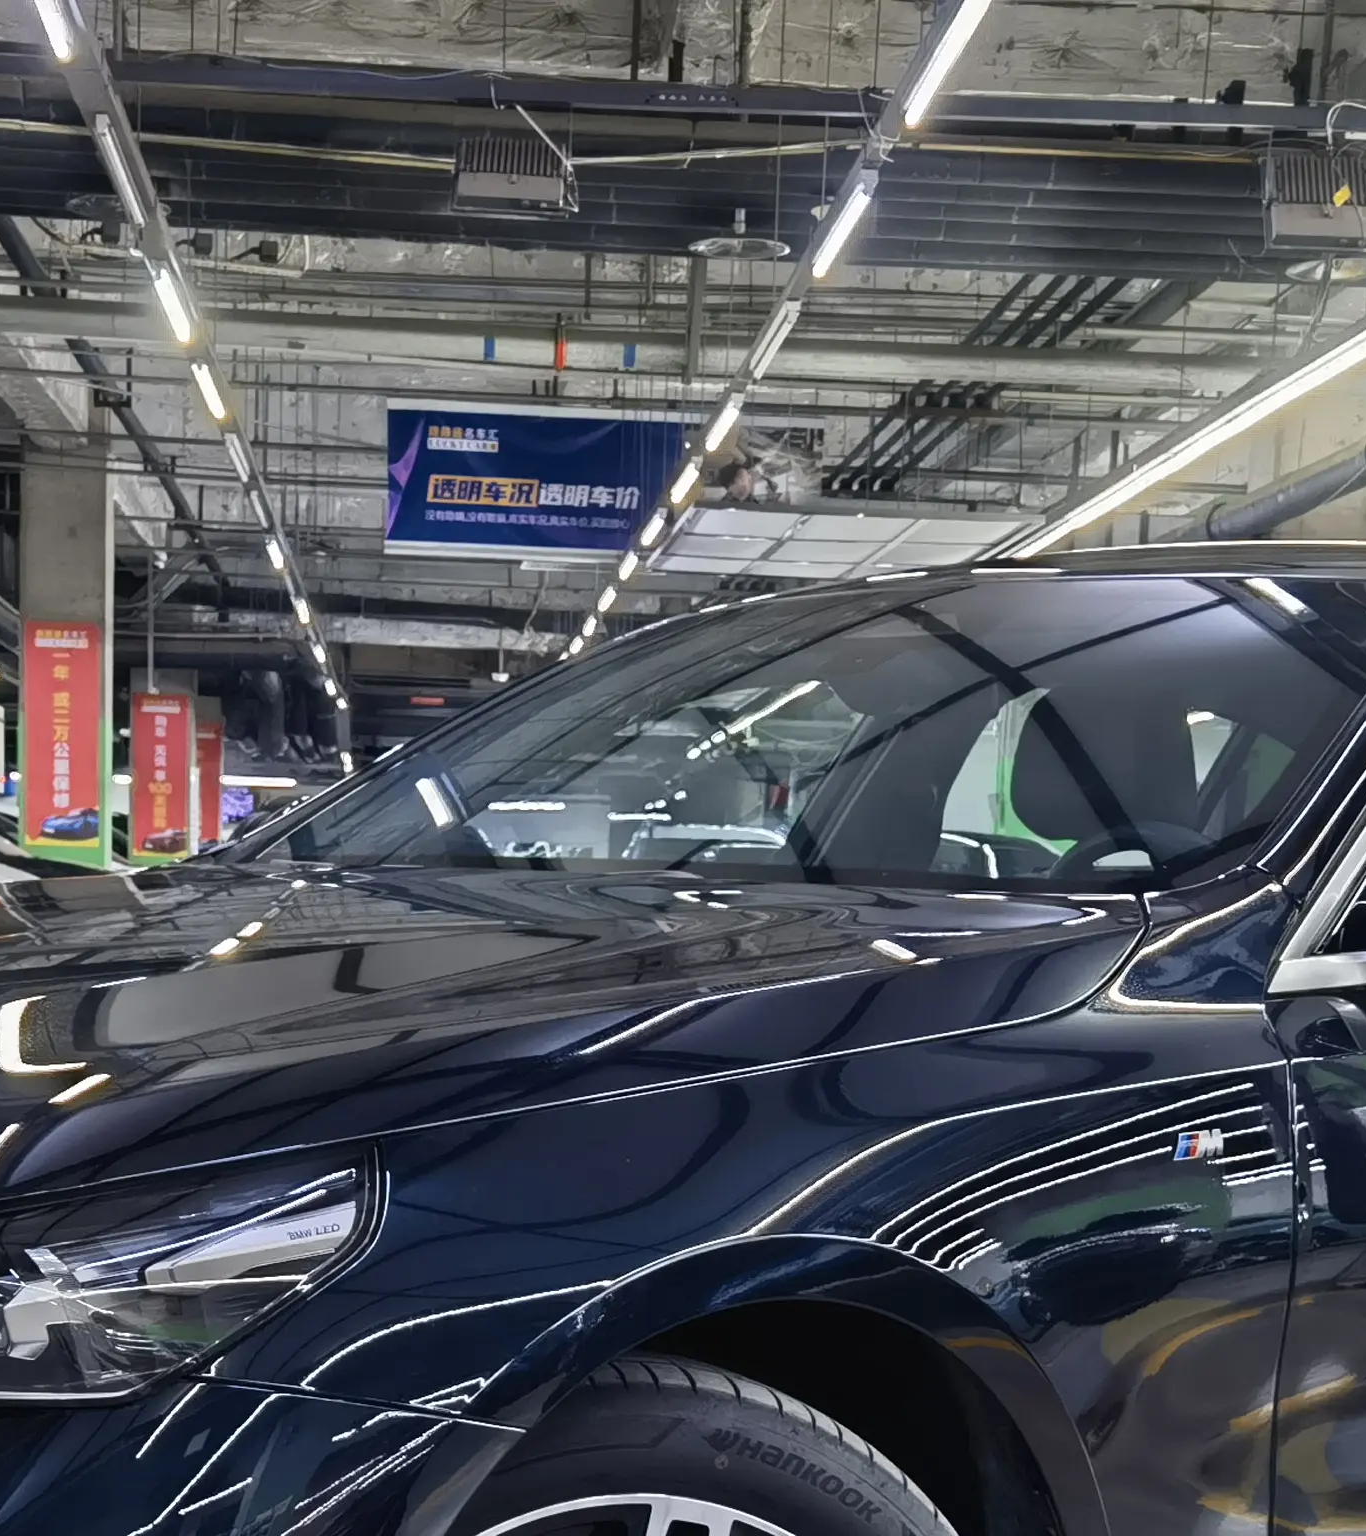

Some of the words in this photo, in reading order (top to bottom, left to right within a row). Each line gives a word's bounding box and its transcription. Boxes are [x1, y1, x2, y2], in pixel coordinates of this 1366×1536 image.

[431, 478, 534, 505] 透明车况
[539, 482, 640, 509] 透明车价
[287, 1229, 312, 1241] BMW
[315, 1224, 340, 1236] LED
